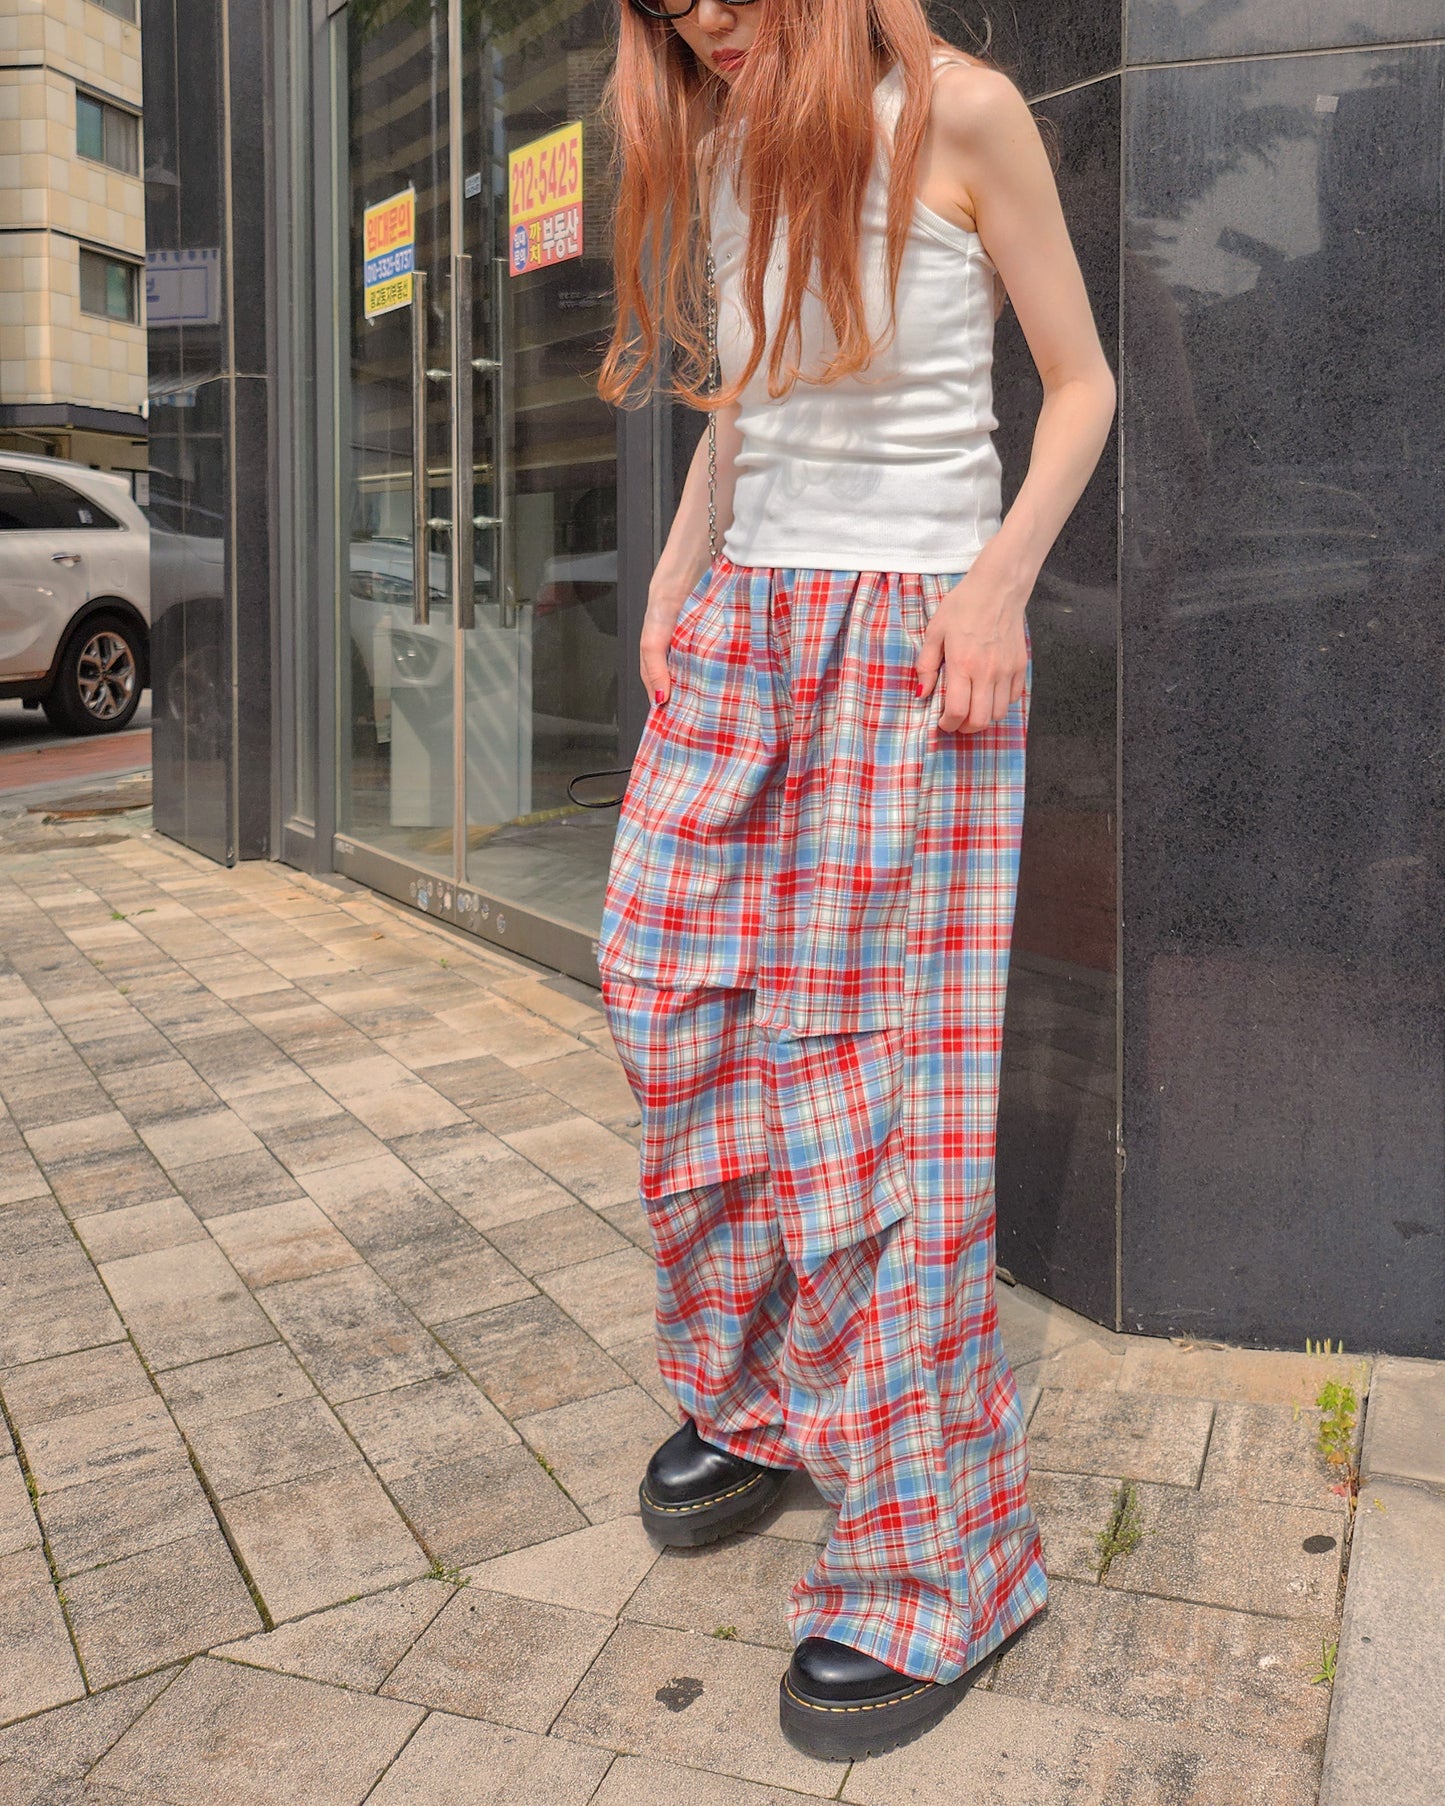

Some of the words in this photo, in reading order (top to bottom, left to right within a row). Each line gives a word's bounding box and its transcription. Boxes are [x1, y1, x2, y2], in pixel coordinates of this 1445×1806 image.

[367, 200, 411, 254] 임대문의
[528, 221, 542, 266] 까치
[542, 207, 579, 260] 부동산
